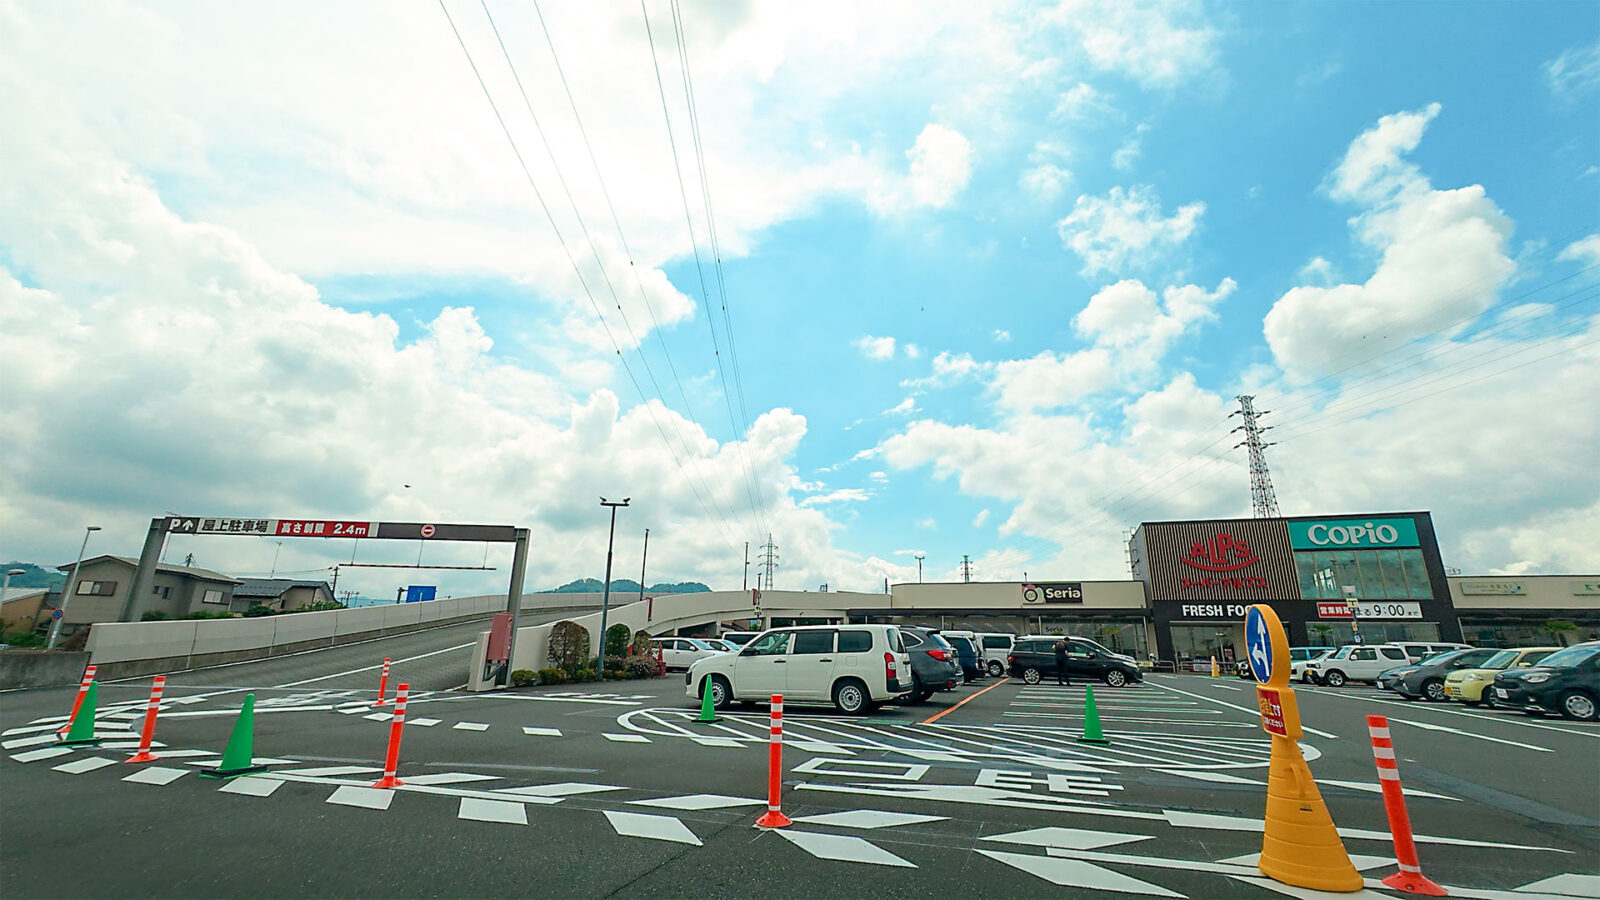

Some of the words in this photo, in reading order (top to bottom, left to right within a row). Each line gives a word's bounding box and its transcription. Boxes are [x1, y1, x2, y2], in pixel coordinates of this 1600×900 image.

[201, 519, 269, 534] 屋上駐車場
[281, 521, 325, 535] 高さ制限
[333, 523, 367, 536] 2.4m
[1190, 533, 1251, 565] ALPS
[1179, 576, 1268, 590] スーパーアルプス
[1045, 587, 1081, 599] Seria
[1182, 604, 1224, 617] FRESH
